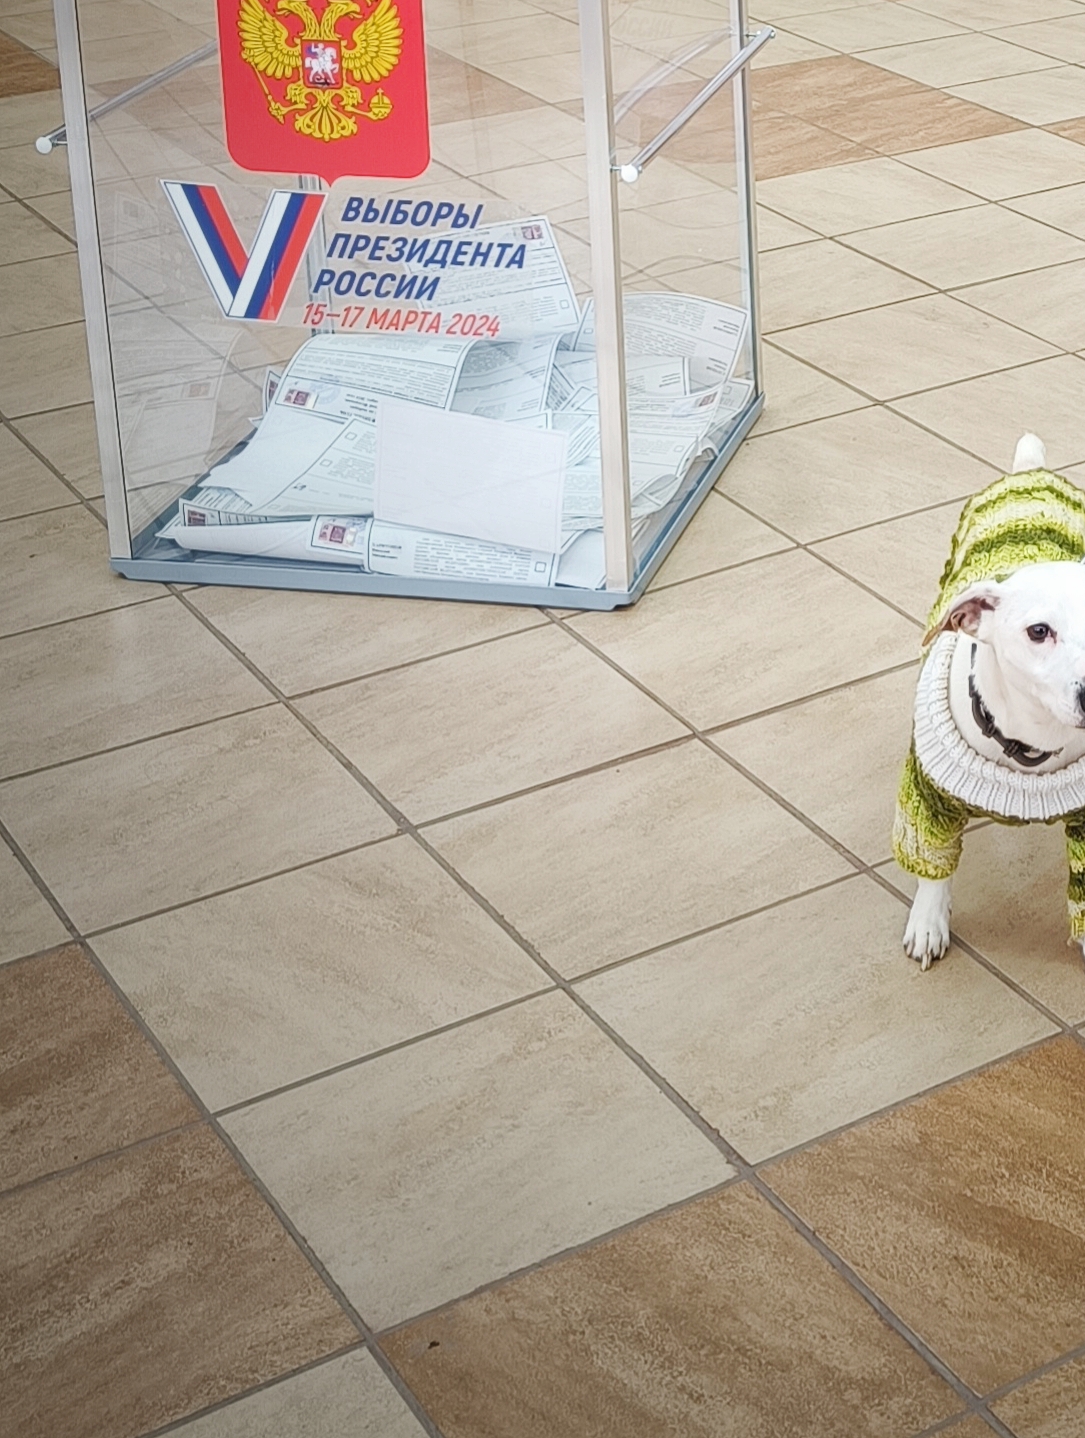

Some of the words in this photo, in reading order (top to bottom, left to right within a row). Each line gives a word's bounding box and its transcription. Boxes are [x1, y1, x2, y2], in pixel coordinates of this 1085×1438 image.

[341, 196, 483, 230] ВЫБОРЫ
[327, 233, 527, 269] ПРЕЗИДЕНТА
[313, 269, 441, 301] РОССИИ
[366, 307, 442, 334] МАРТА
[445, 313, 502, 337] 2024
